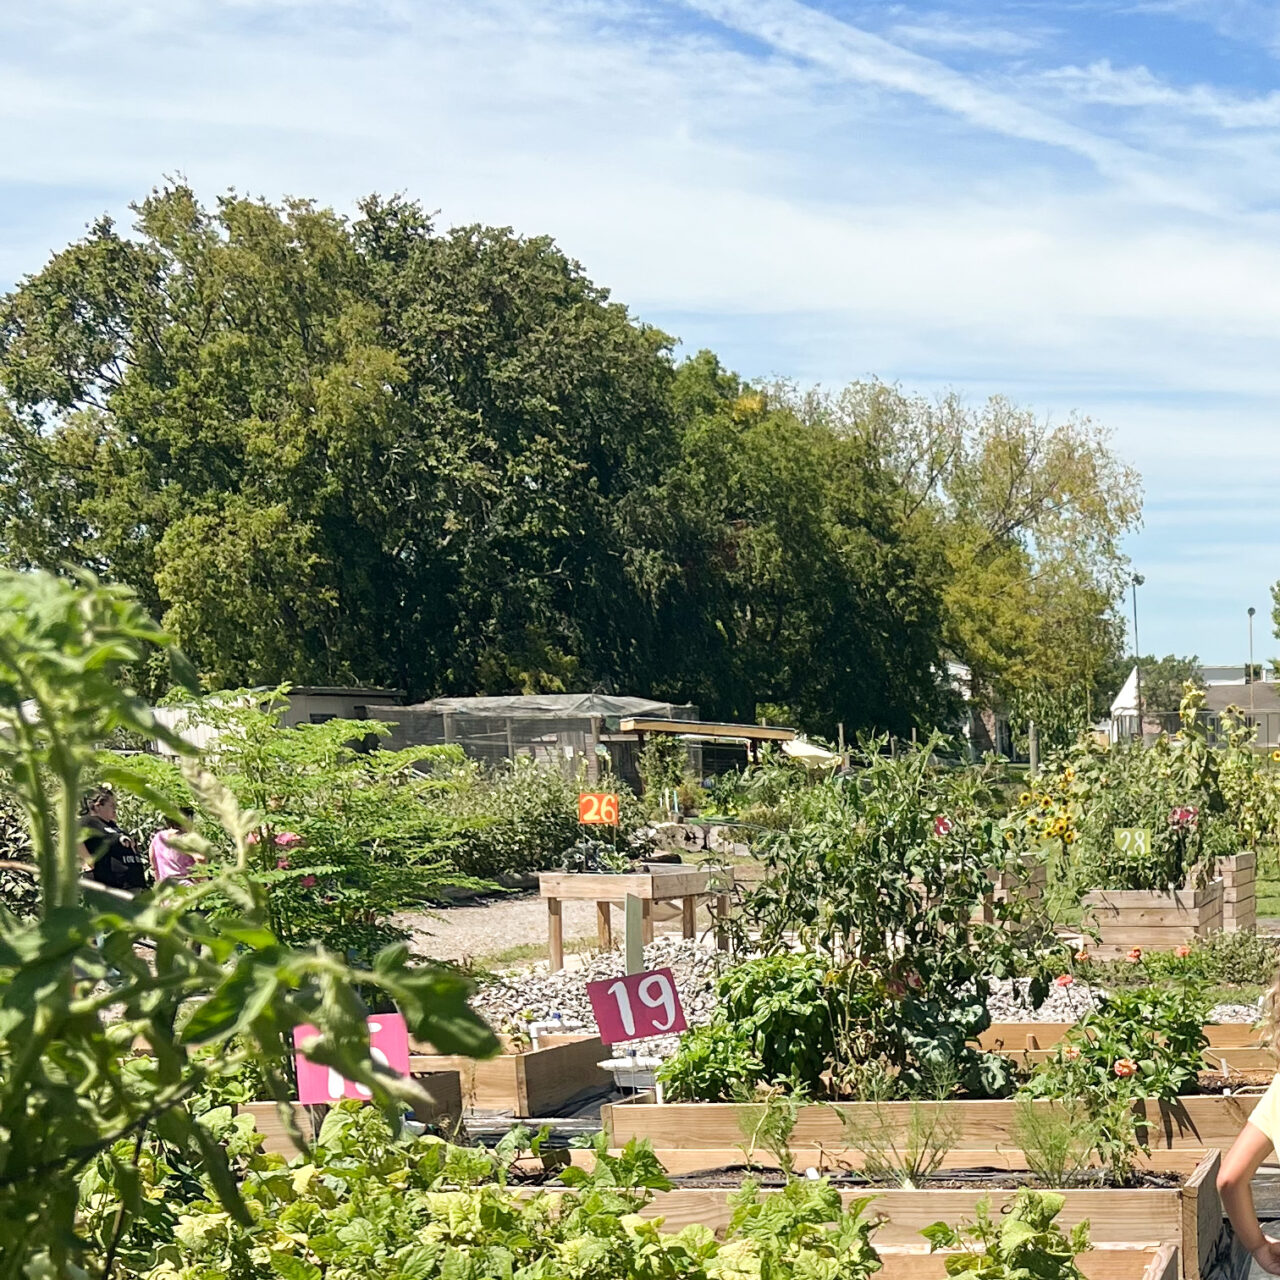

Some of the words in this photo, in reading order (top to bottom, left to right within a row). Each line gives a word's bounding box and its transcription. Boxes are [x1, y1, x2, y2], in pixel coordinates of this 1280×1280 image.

[581, 795, 615, 822] 26
[1120, 830, 1146, 855] 28
[607, 974, 676, 1036] 19
